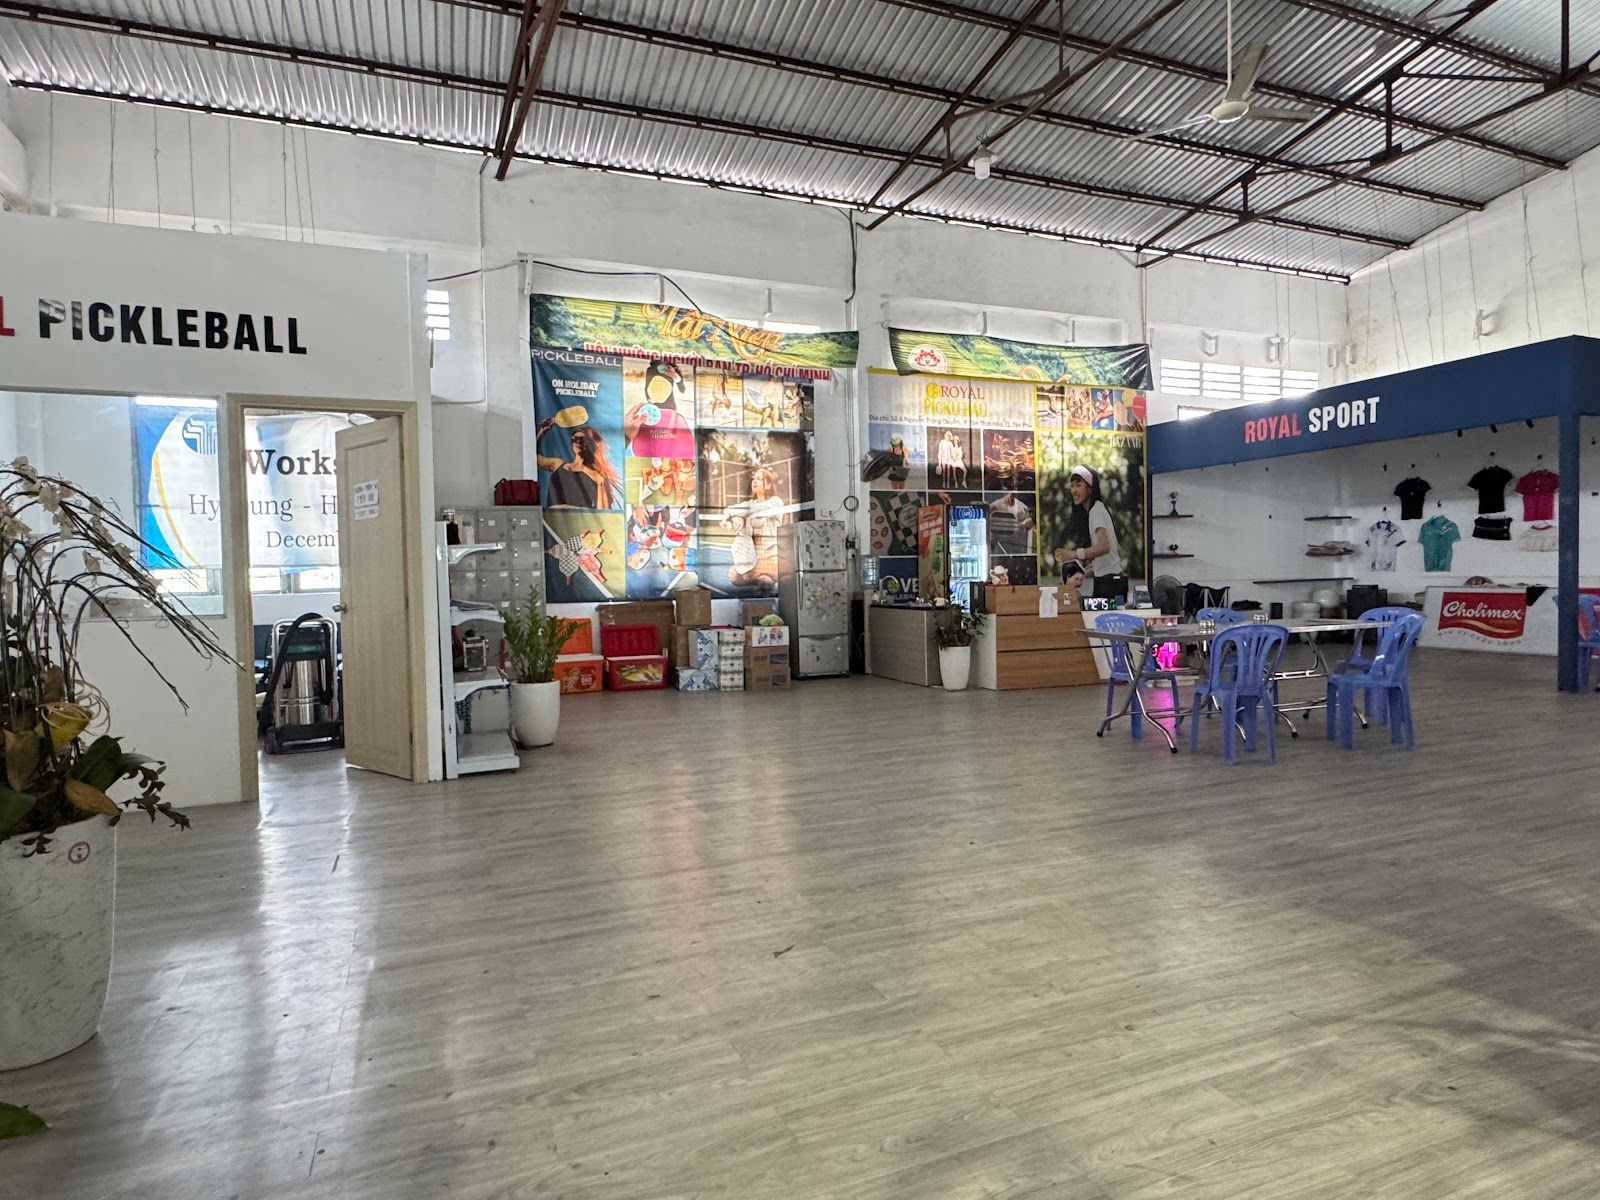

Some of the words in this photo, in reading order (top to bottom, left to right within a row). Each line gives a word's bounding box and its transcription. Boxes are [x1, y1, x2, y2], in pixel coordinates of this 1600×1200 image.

[38, 298, 307, 354] PICKLEBALL
[531, 348, 622, 367] PICKLEBALL
[798, 367, 831, 382] MINH
[552, 378, 564, 388] ON
[565, 380, 600, 392] HOLIDAY
[940, 385, 985, 400] ROYAL
[1244, 412, 1301, 444] ROYAL
[1308, 396, 1381, 434] SPORT
[245, 447, 337, 476] Work
[266, 530, 338, 548] Decem
[1442, 601, 1523, 620] Cholimex
